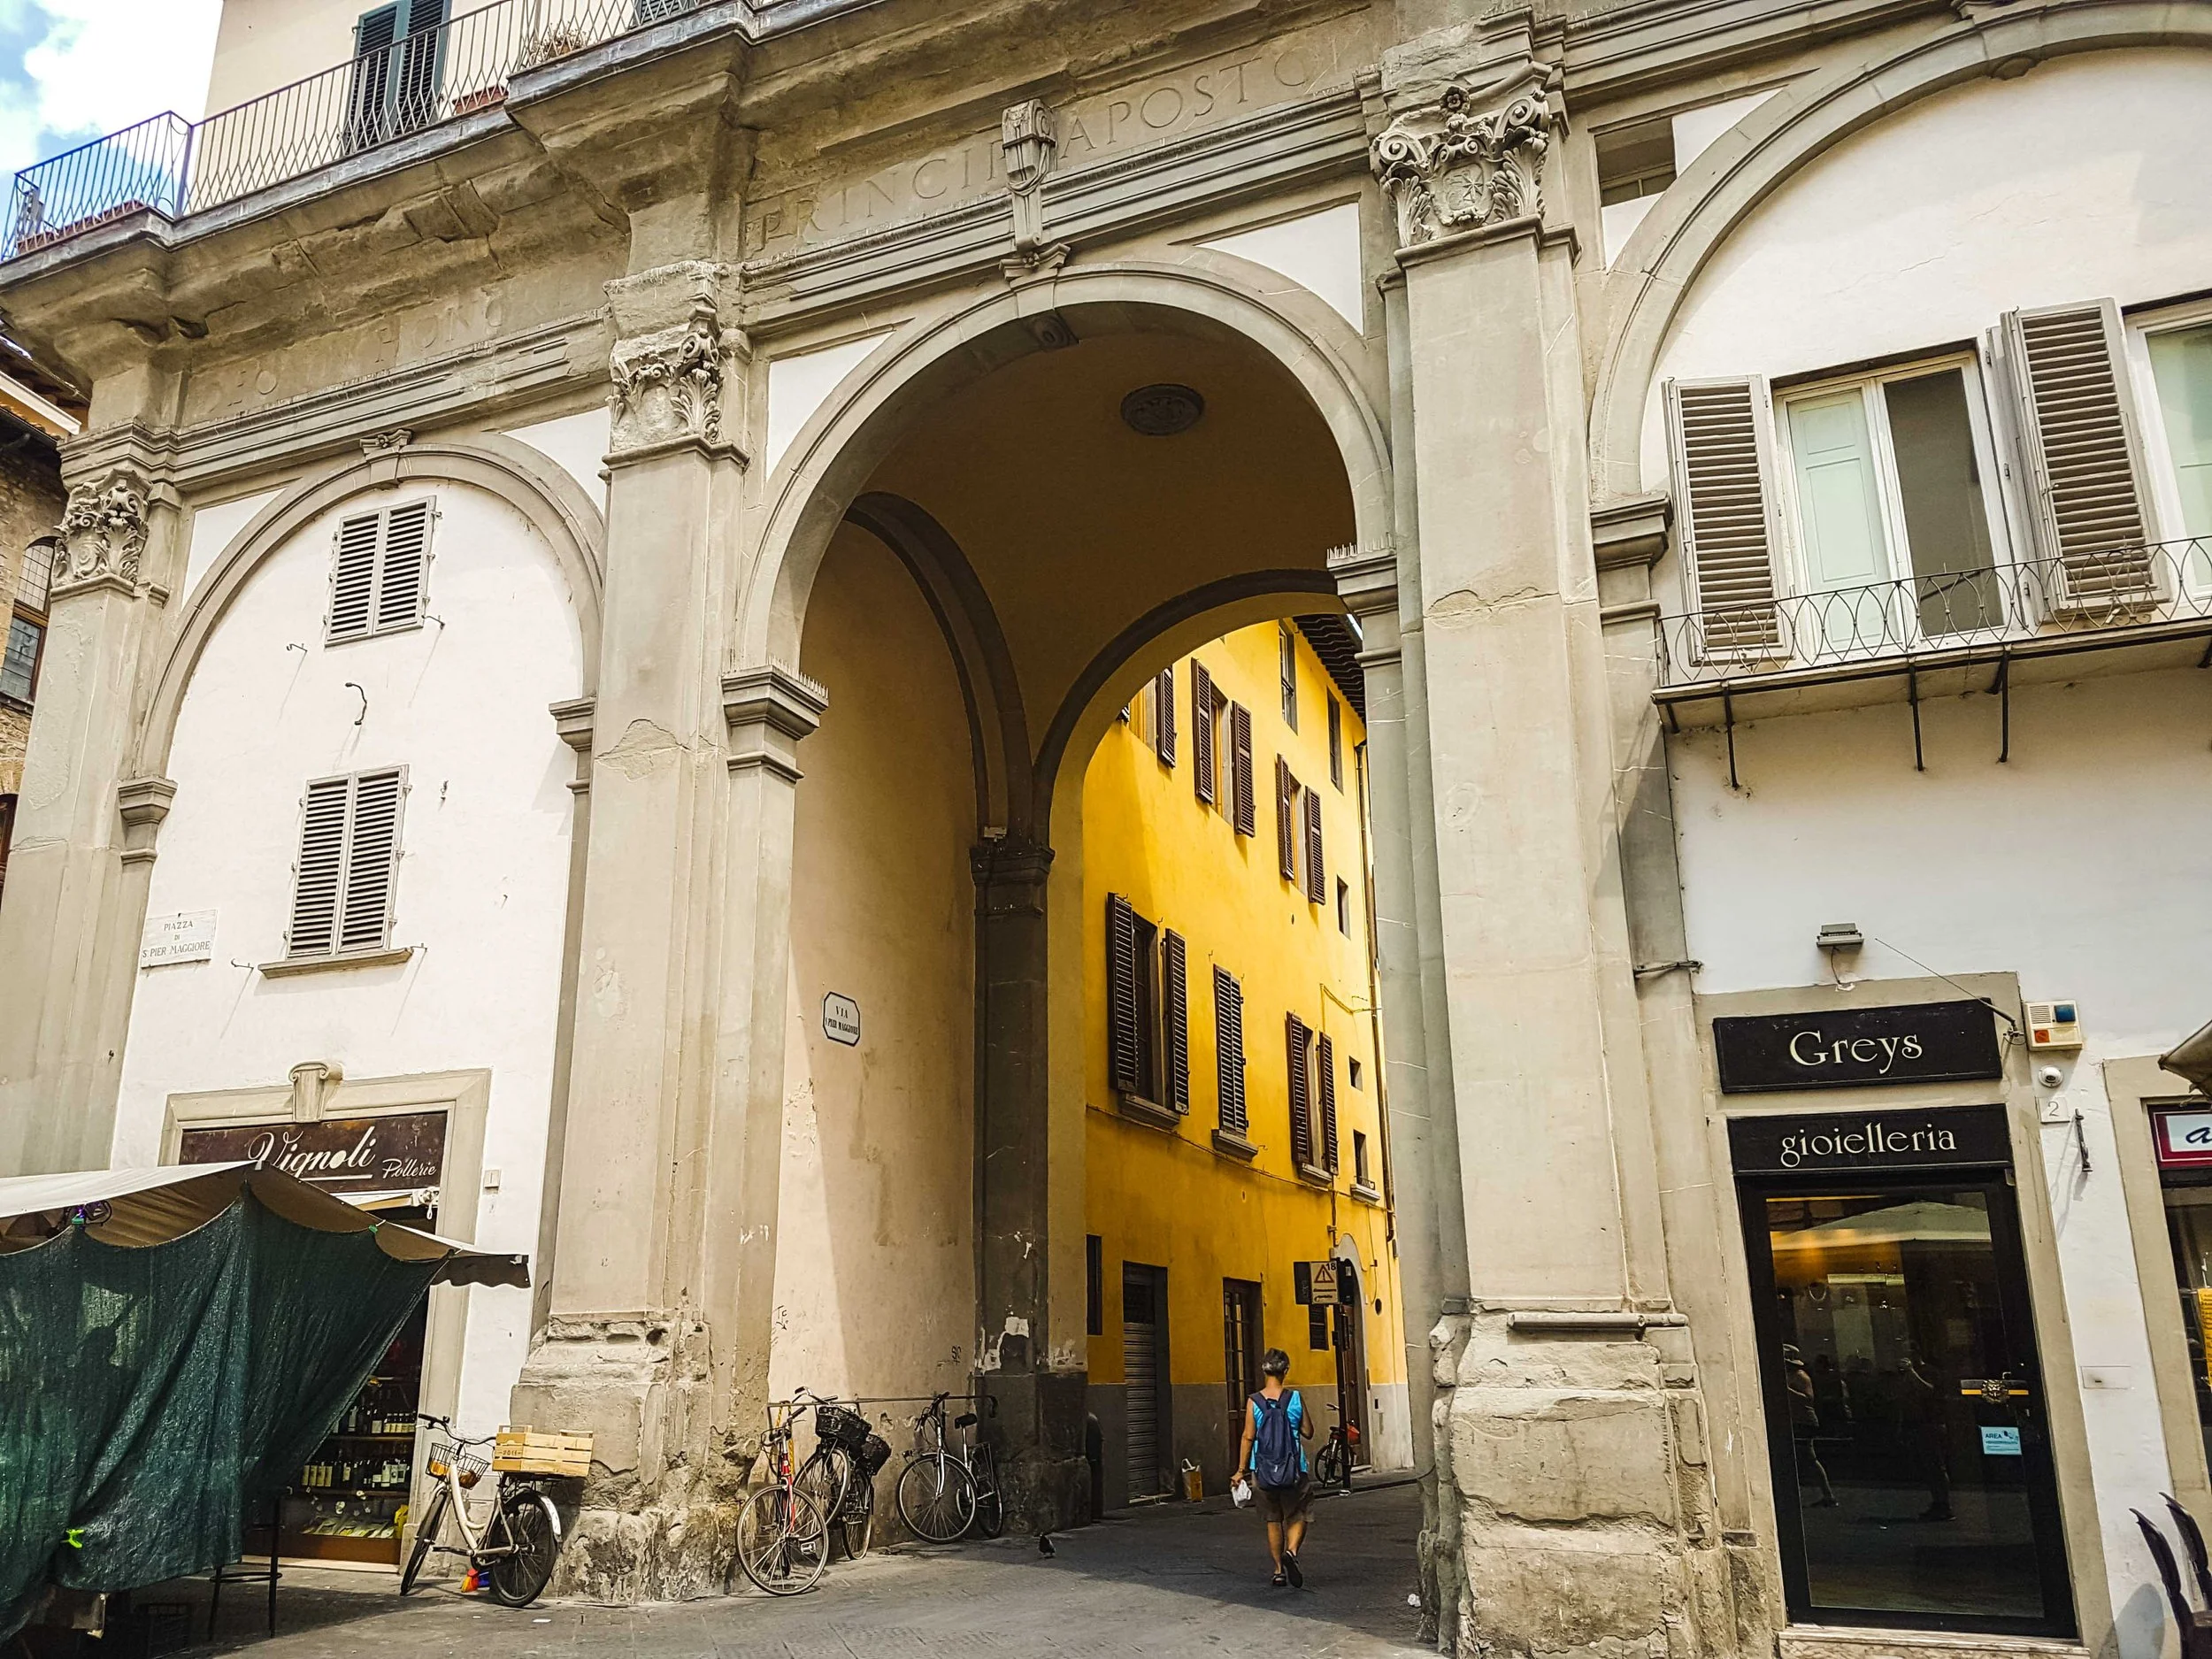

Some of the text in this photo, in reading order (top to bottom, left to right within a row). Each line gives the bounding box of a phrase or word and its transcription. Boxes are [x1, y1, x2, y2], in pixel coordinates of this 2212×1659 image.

[164, 920, 194, 931] PIAZZA
[150, 947, 166, 957] PIER
[170, 941, 211, 955] MAGGIORE
[835, 1005, 849, 1018] VIA
[1789, 1030, 1923, 1074] Greys
[2047, 1101, 2060, 1117] 2
[248, 1125, 437, 1179] Vignoli Pollerie
[1780, 1122, 1957, 1168] gioielleria
[1325, 1262, 1337, 1271] 18
